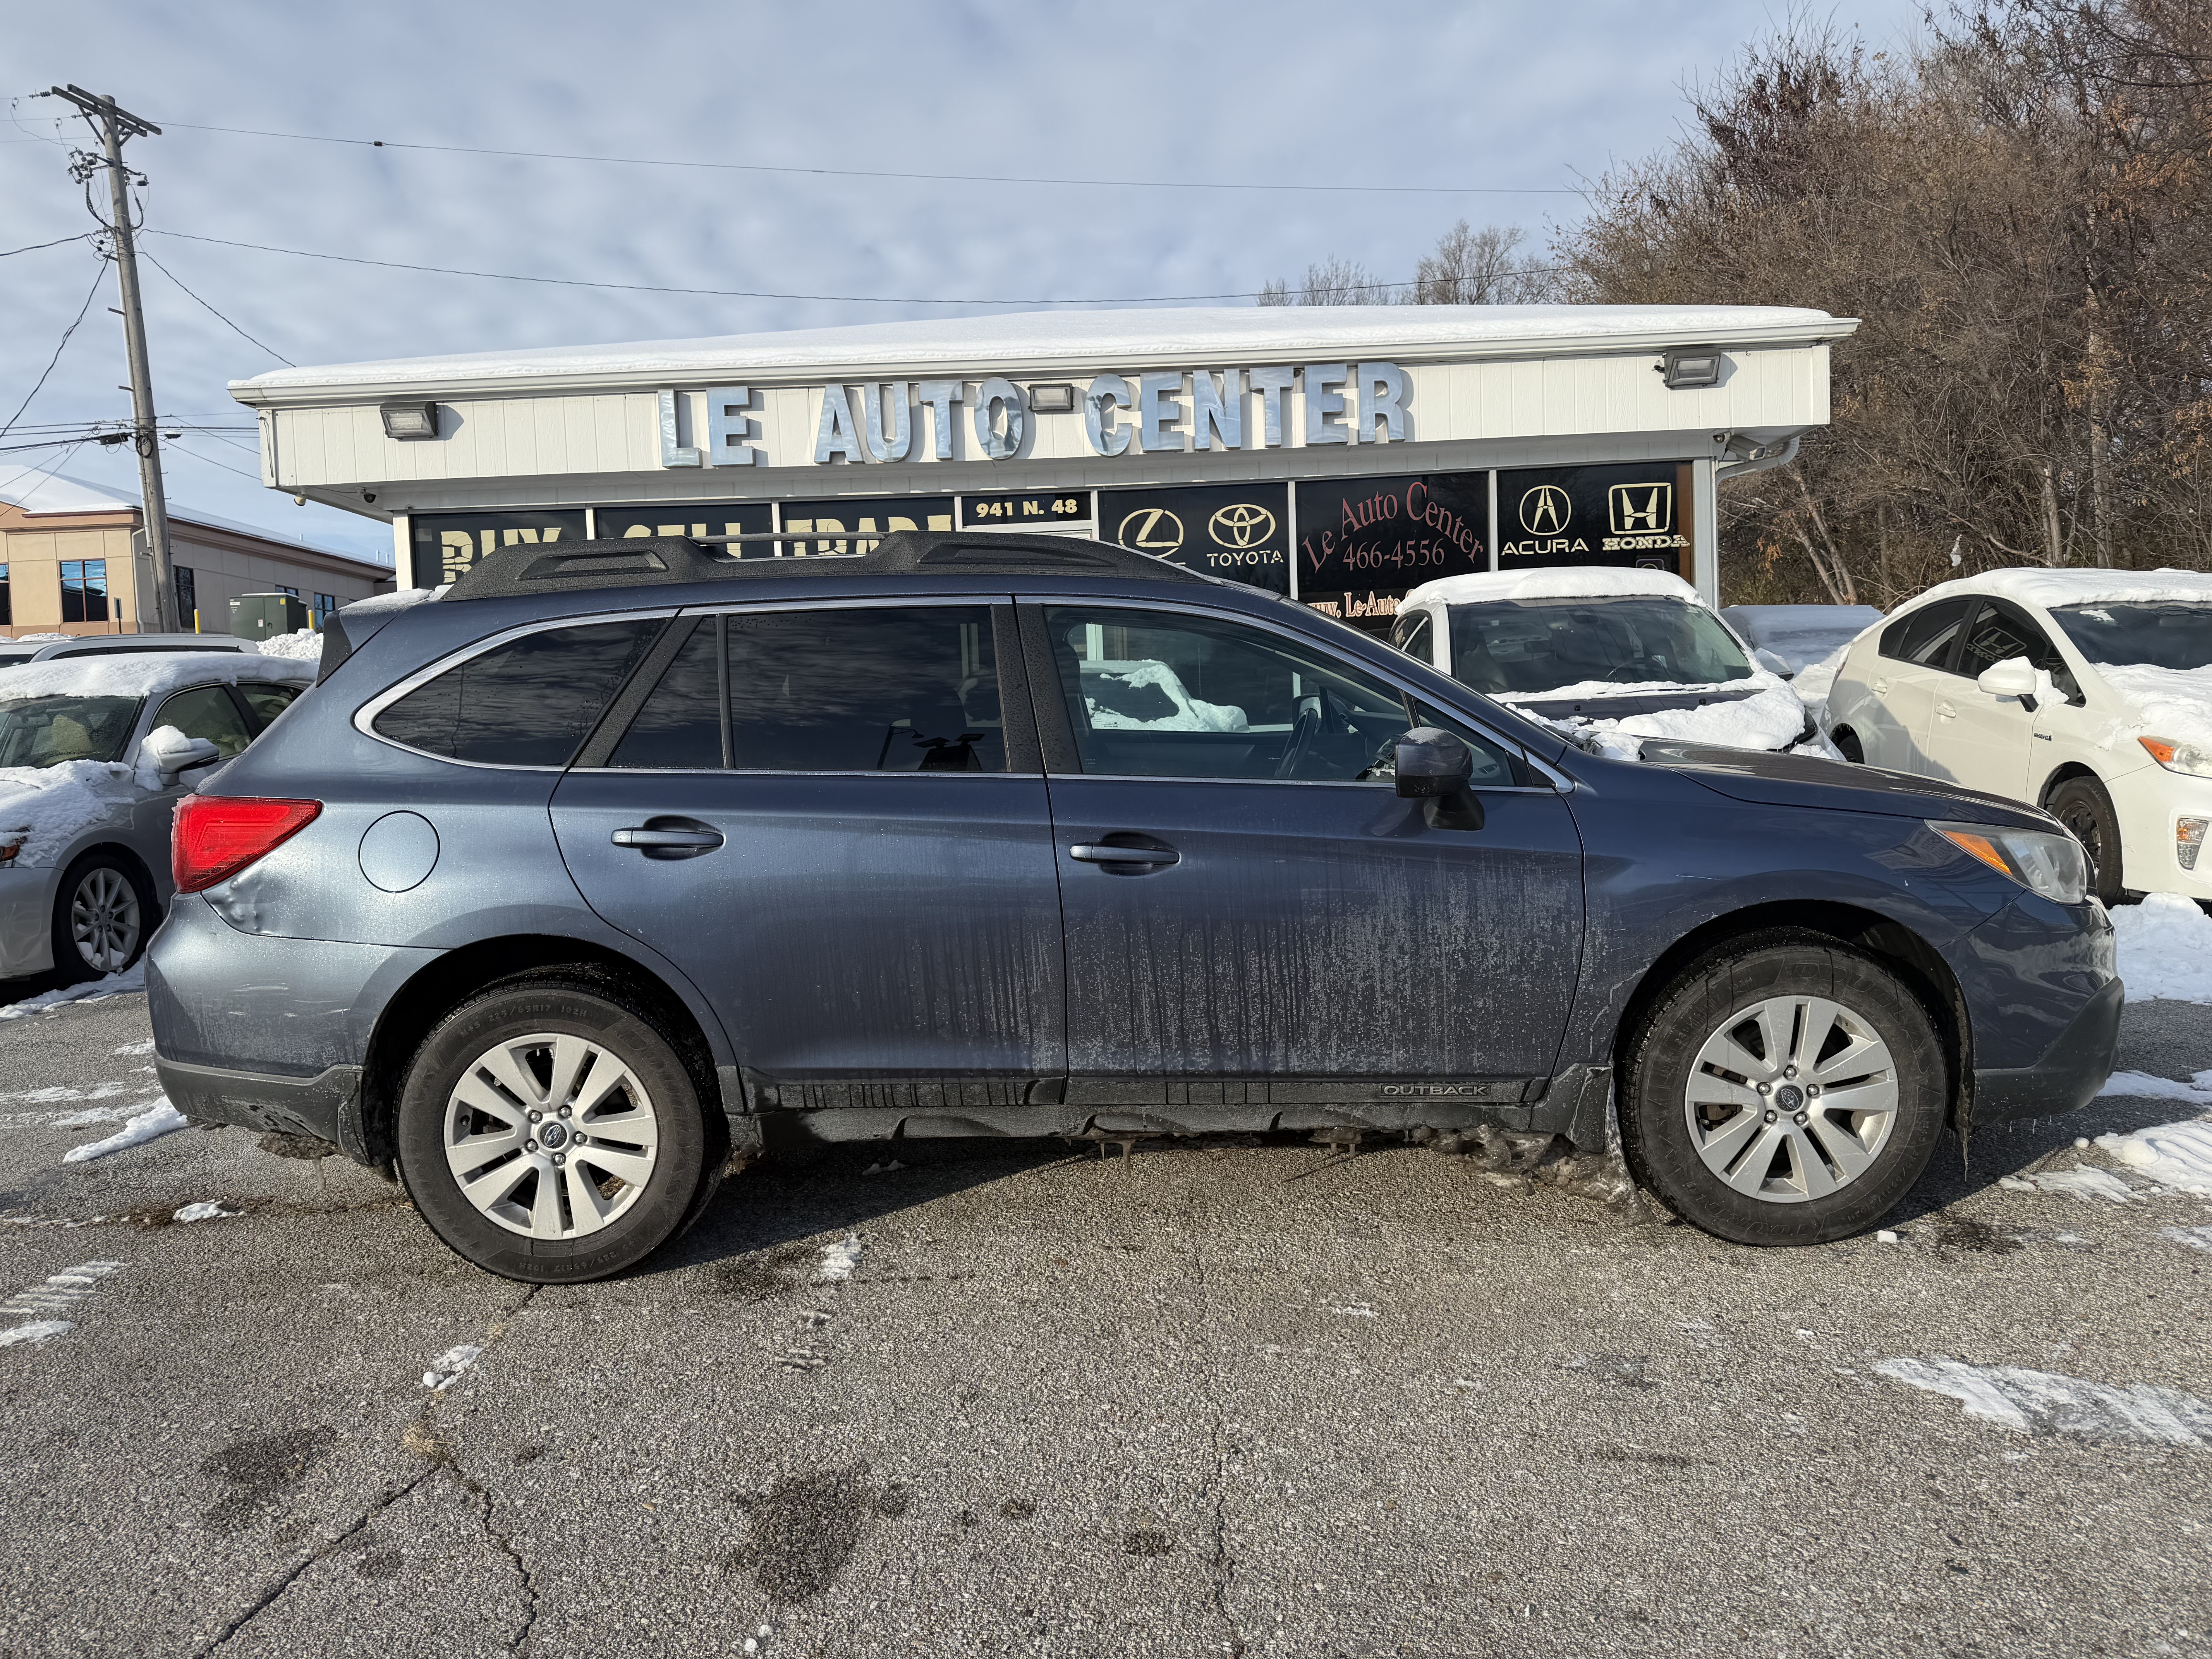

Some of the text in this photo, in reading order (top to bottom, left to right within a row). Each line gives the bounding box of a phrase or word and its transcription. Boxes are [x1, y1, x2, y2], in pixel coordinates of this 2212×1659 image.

[658, 362, 1405, 468] LE AUTO CENTER
[976, 499, 1078, 518] 941 N. 48
[1302, 482, 1484, 573] Le Auto Center
[1501, 538, 1589, 556] ACURA
[1602, 534, 1690, 551] HONDA
[1206, 550, 1284, 567] TOYOTA
[1343, 538, 1444, 571] 466-4556
[485, 1003, 551, 1024] 225/65R17
[561, 1005, 587, 1017] 102H
[1384, 1085, 1488, 1096] OUTBACK
